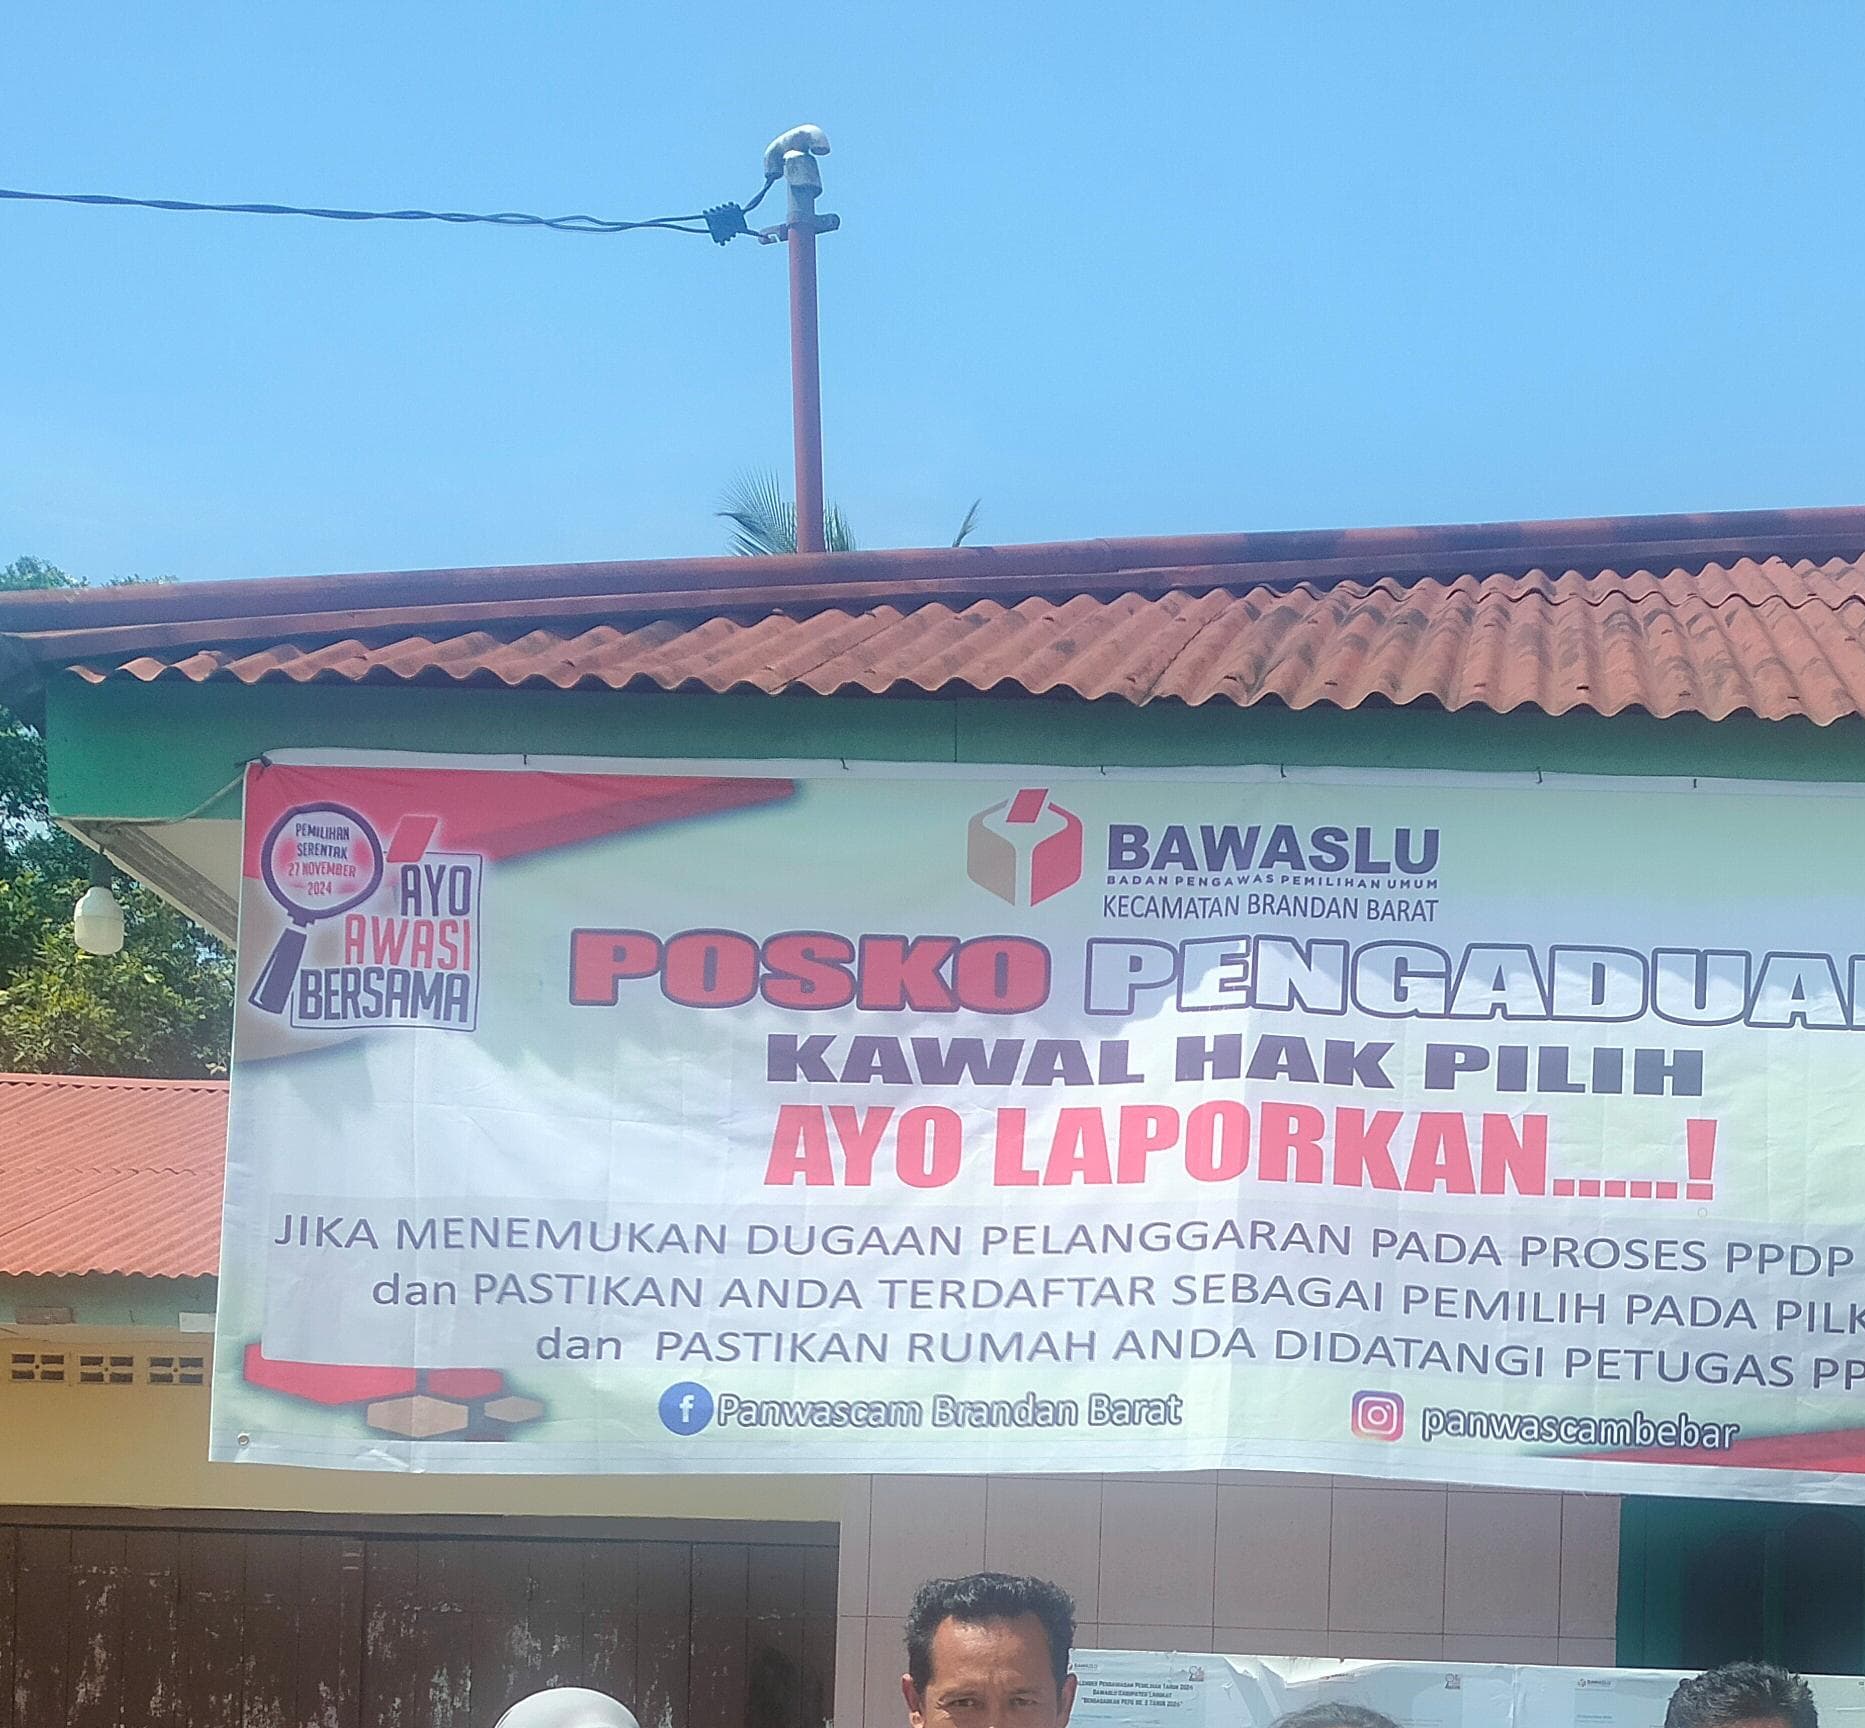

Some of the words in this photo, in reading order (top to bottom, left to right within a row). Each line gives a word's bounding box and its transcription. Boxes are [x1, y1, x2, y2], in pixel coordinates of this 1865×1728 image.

[295, 822, 350, 841] PEMILIHAN
[296, 842, 348, 860] SERENTAK
[1107, 823, 1440, 875] BAWASLU
[288, 862, 300, 877] 27
[301, 861, 357, 878] NOVEMBER
[307, 881, 332, 896] 2024
[400, 864, 472, 916] AYO
[1107, 875, 1168, 886] BADAN
[1175, 873, 1274, 888] PENGAWAS
[1280, 874, 1380, 889] PEMILIHAN
[1387, 879, 1438, 890] UMUM
[1103, 893, 1240, 920] KECAMATAN
[1247, 893, 1359, 920] BRANDAN
[1366, 898, 1439, 922] BARAT
[345, 914, 471, 971] AWASI
[299, 966, 471, 1022] BERSAMA
[569, 927, 1052, 1016] POSKO
[766, 1032, 1146, 1086] KAWAL
[1174, 1033, 1395, 1089] HAK
[1424, 1042, 1704, 1097] PILIH
[763, 1103, 963, 1188] AYO
[274, 1213, 379, 1250] JIKA
[395, 1215, 726, 1256] MENEMUKAN
[745, 1222, 963, 1257] DUGAAN
[982, 1219, 1352, 1257] PELANGGARAN
[1371, 1227, 1503, 1267] PADA
[1520, 1236, 1708, 1274] PROSES
[1725, 1240, 1855, 1279] PPDP
[372, 1272, 457, 1306] dan
[473, 1272, 703, 1309] PASTIKAN
[718, 1276, 863, 1310] ANDA
[878, 1274, 1155, 1310] TERDAFTAR
[1171, 1272, 1383, 1313] SEBAGAI
[1402, 1284, 1606, 1324] PEMILIH
[1625, 1292, 1757, 1331] PADA
[535, 1327, 623, 1361] dan
[654, 1329, 887, 1364] PASTIKAN
[906, 1330, 1097, 1364] RUMAH
[1112, 1326, 1257, 1361] ANDA
[1273, 1328, 1544, 1378] DIDATANGI
[1565, 1346, 1795, 1388] PETUGAS
[716, 1392, 923, 1429] Panwascam
[932, 1392, 1079, 1428] Brandan
[1087, 1392, 1183, 1428] Barat
[1420, 1401, 1740, 1450] panwascambebar
